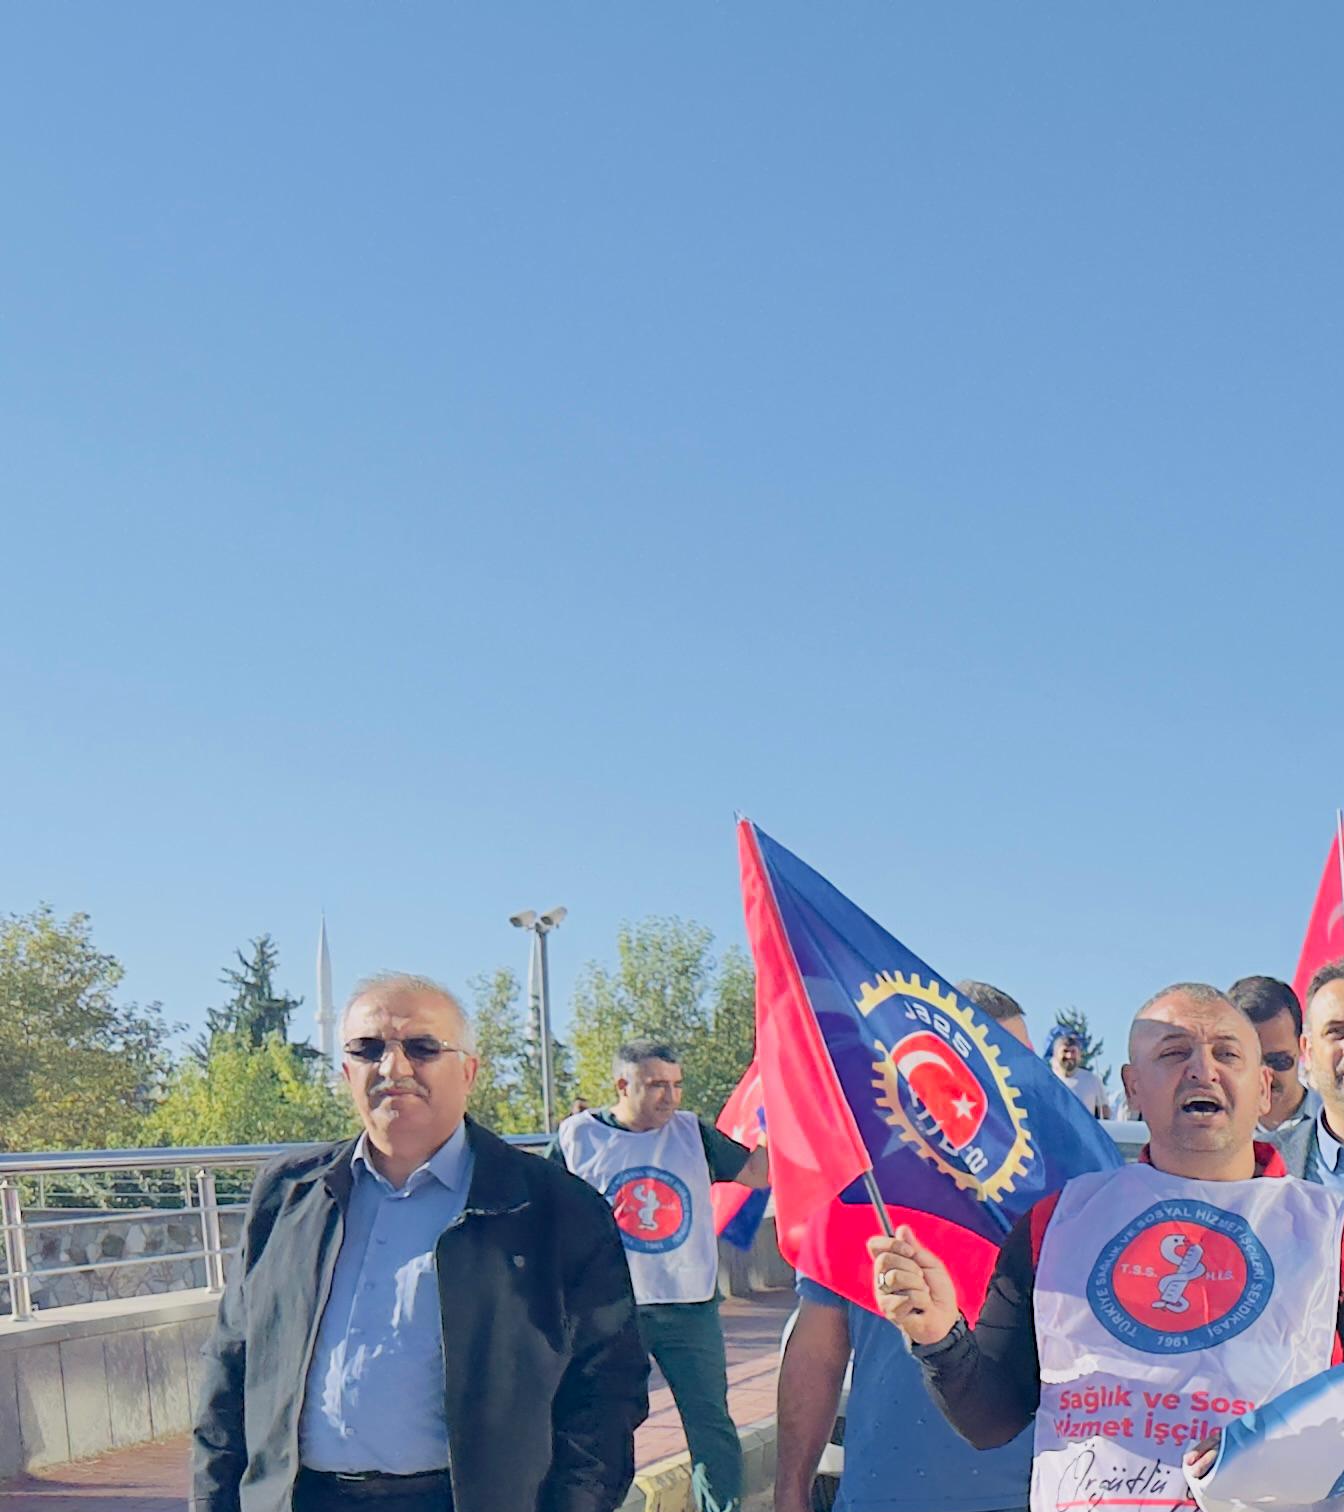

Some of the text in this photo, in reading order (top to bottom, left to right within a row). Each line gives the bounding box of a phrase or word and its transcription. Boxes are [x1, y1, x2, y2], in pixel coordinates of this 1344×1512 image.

[1138, 1207, 1192, 1229] SOSYAL
[1157, 1335, 1189, 1348] 1961
[1059, 1384, 1255, 1415] Sağlık ve Sos
